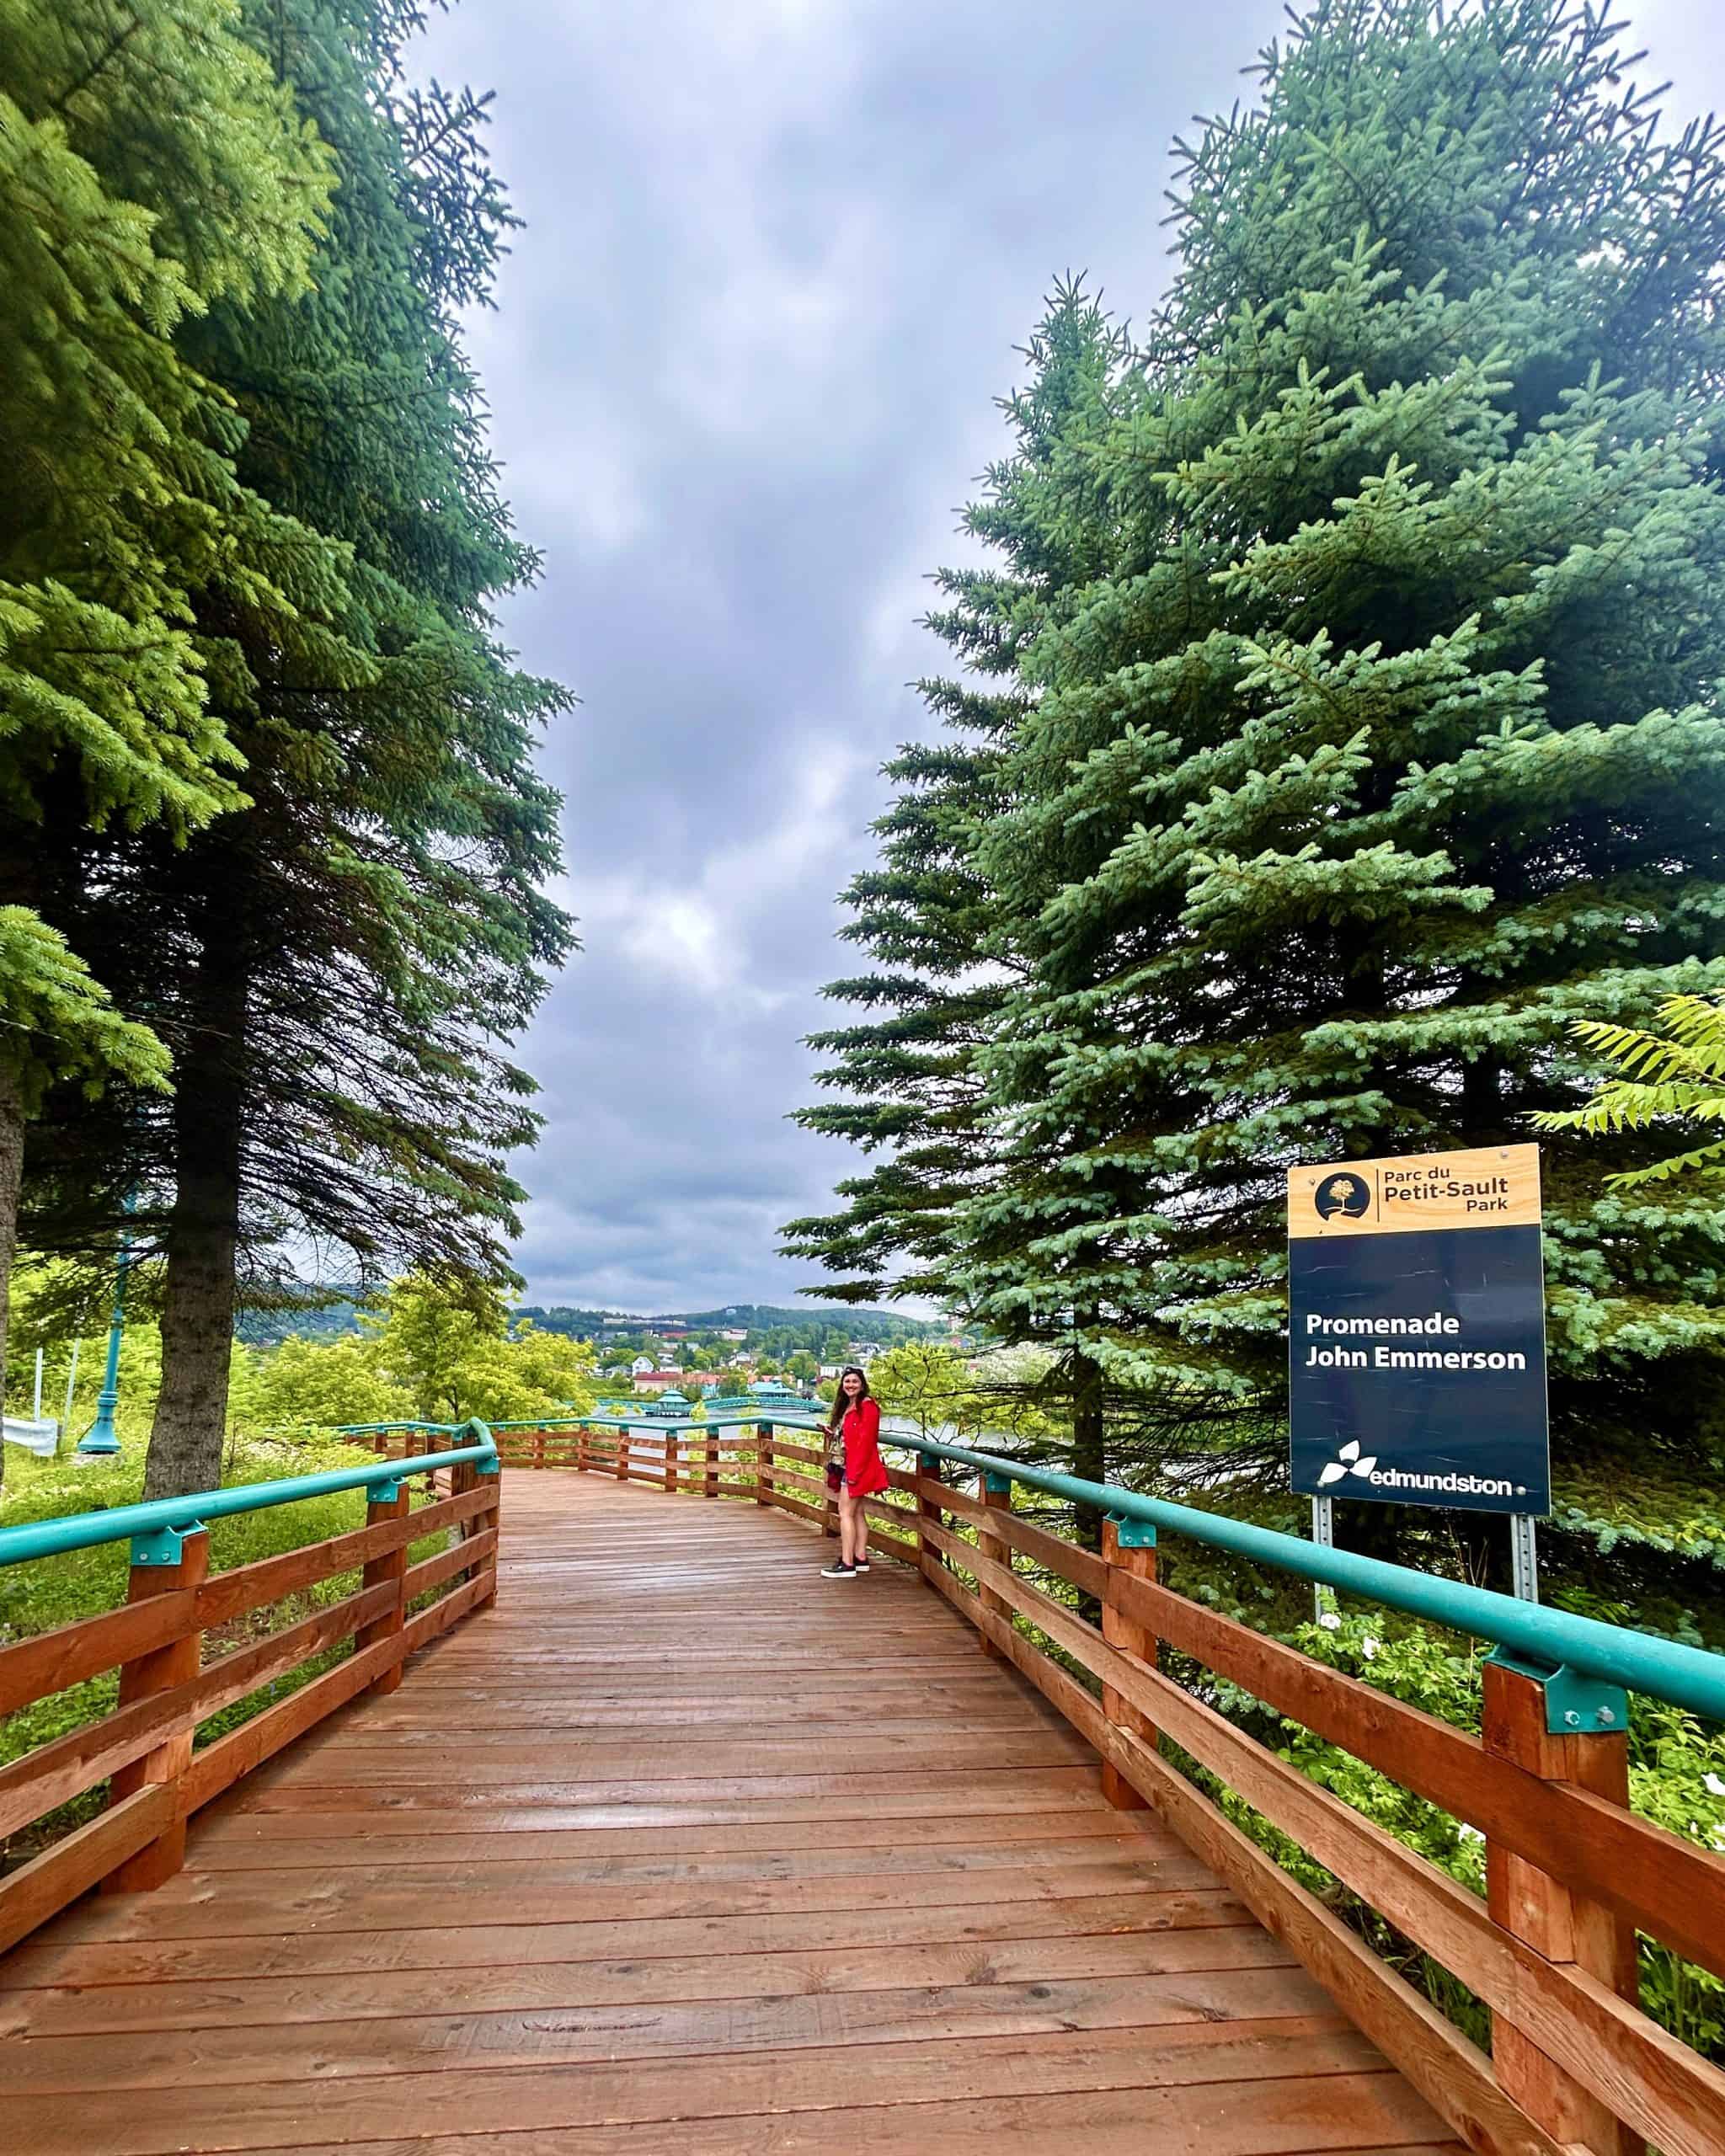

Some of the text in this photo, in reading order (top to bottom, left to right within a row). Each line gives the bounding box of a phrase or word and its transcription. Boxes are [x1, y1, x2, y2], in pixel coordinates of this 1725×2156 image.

[1385, 1166, 1450, 1182] Parc du
[1385, 1177, 1509, 1202] Petit-Sault
[1466, 1198, 1508, 1212] Park
[1306, 1312, 1460, 1334] Promenade
[1306, 1345, 1526, 1369] John Emmerson
[1370, 1469, 1512, 1496] edmundston
